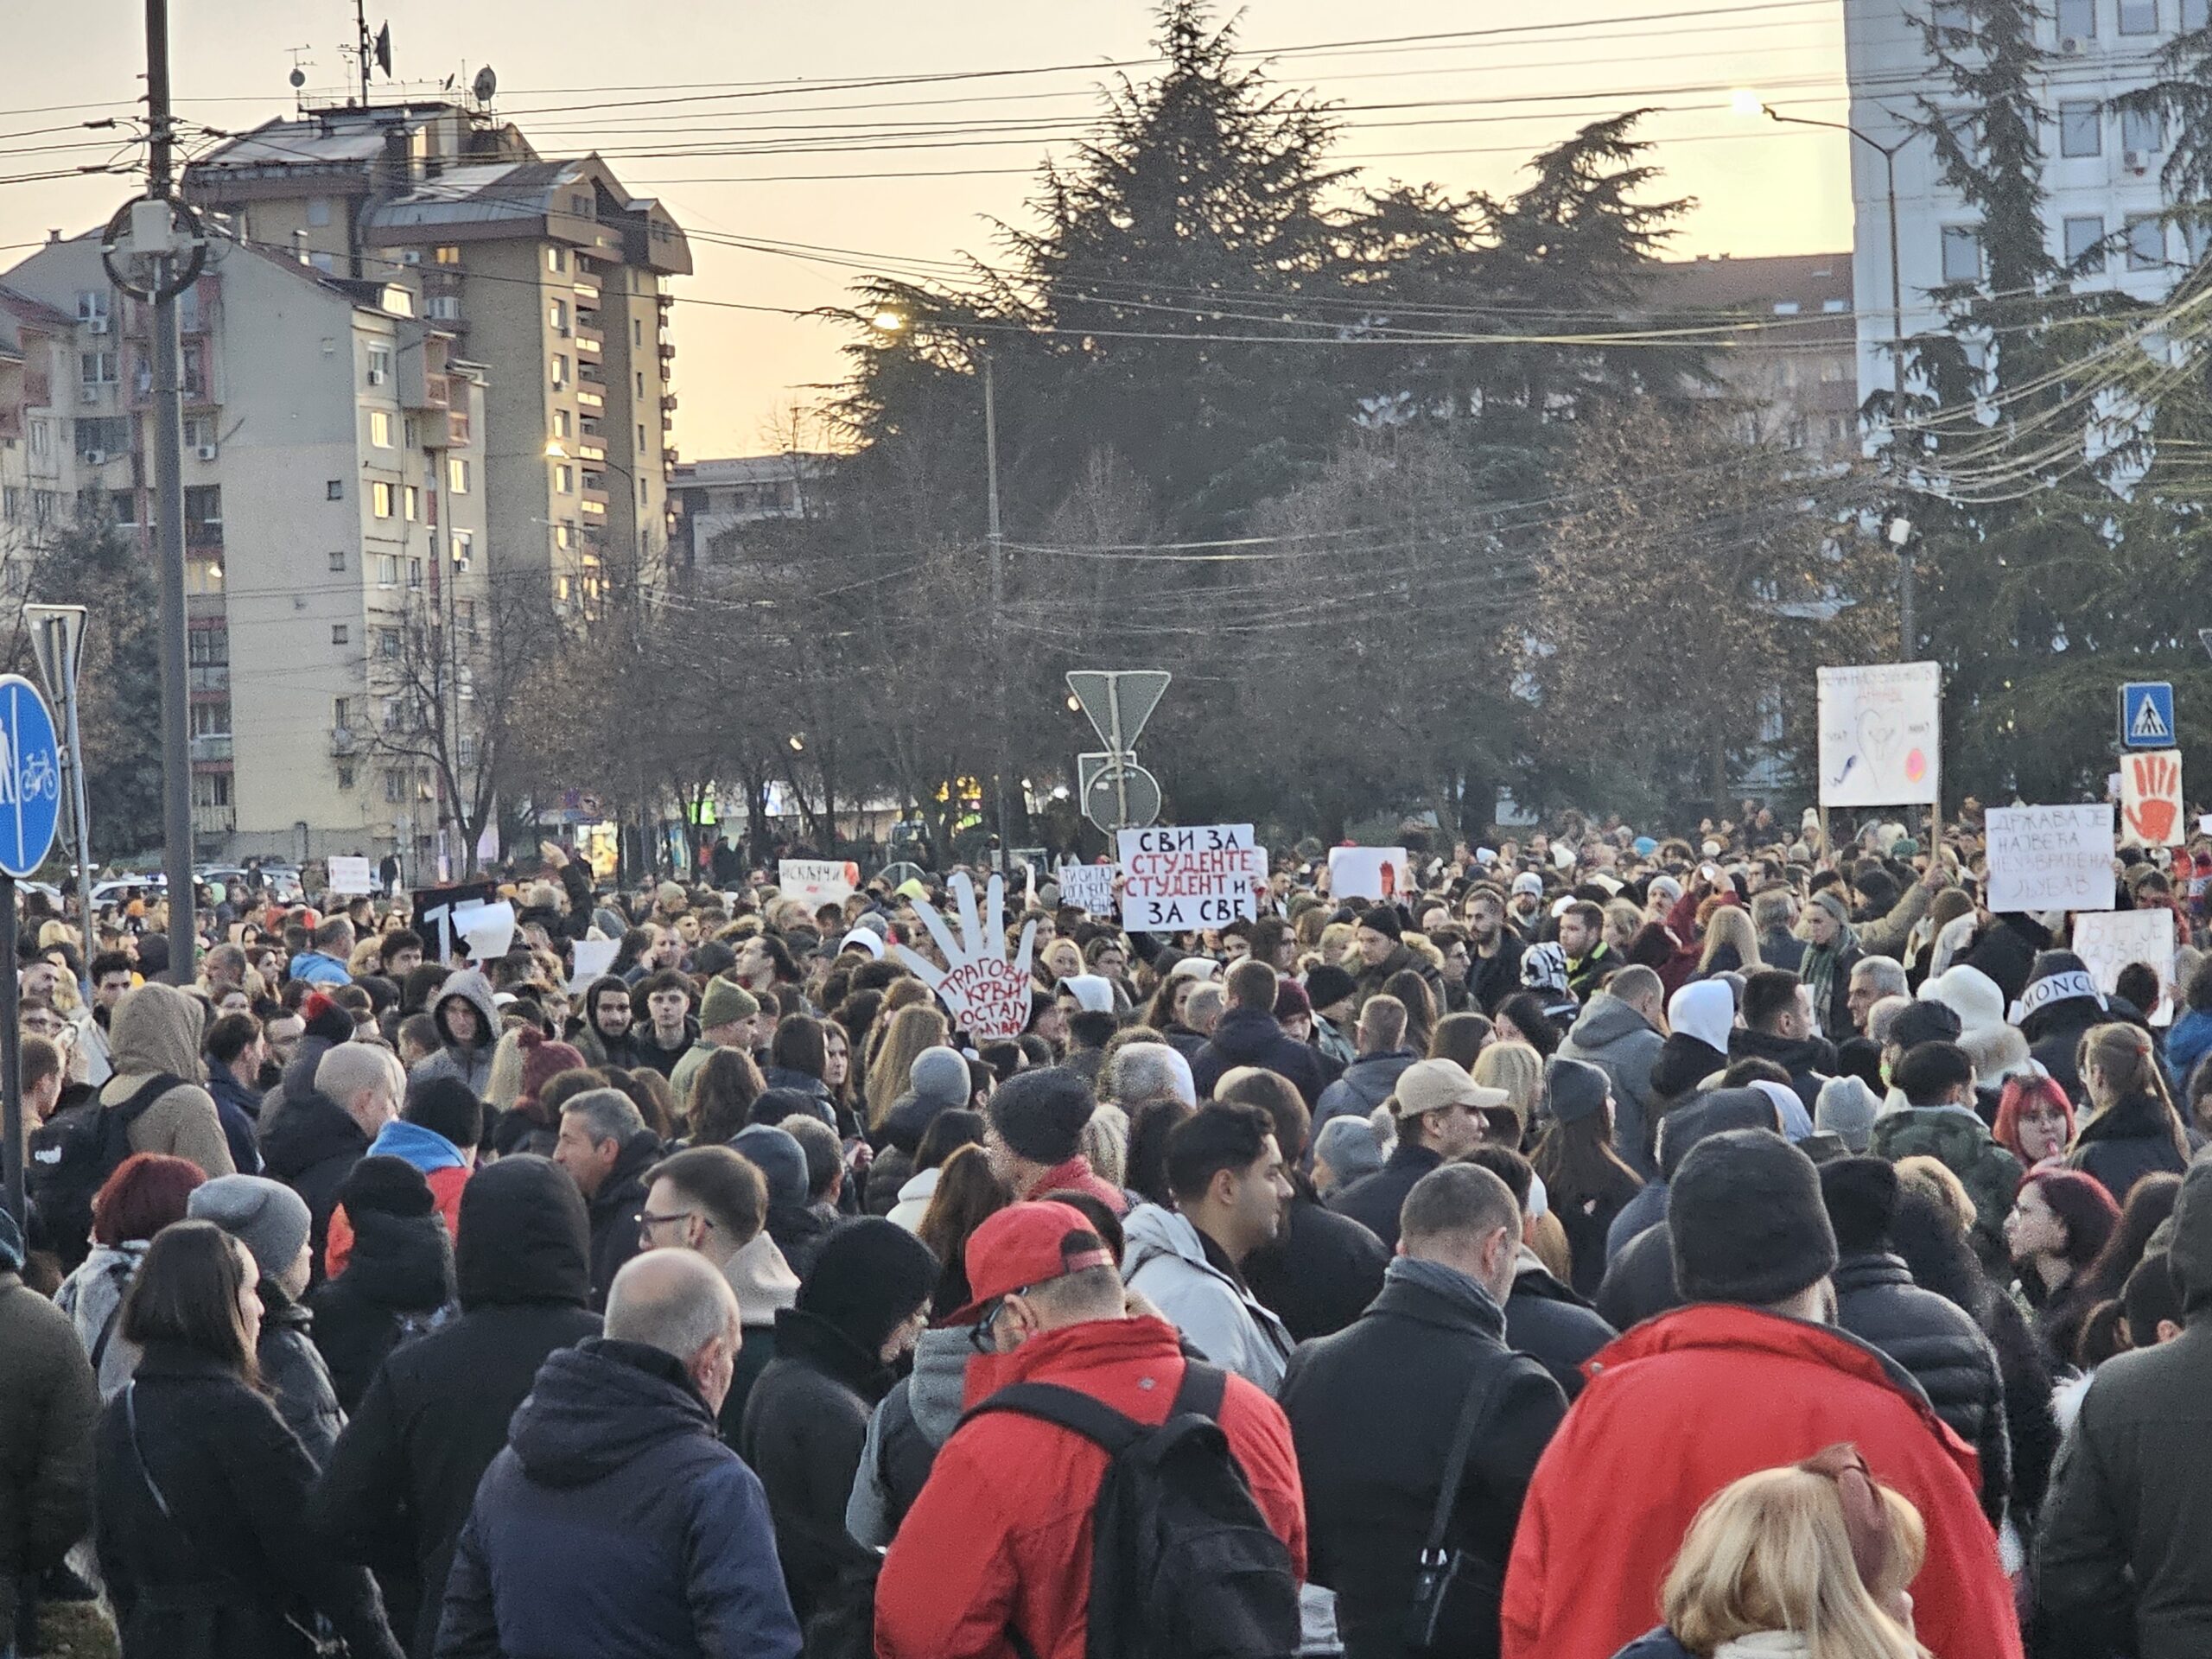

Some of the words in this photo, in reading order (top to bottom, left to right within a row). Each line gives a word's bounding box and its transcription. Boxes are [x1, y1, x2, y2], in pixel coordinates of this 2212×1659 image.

[1990, 810, 2080, 832] ДРЖАВА
[2086, 809, 2107, 827] ЈЕ
[1139, 830, 1194, 853] СВИ
[1207, 830, 1239, 850] ЗА
[1998, 832, 2080, 853] НАЈВЕЋА
[1131, 849, 1253, 874] СТУДЕНТЕ
[1148, 901, 1184, 925] ЗА
[1199, 899, 1245, 922] СВЕ
[938, 957, 1030, 995] ТРАГОВИ
[964, 981, 1022, 1007] КРВИ
[960, 1001, 1028, 1026] ОСТАЈУ
